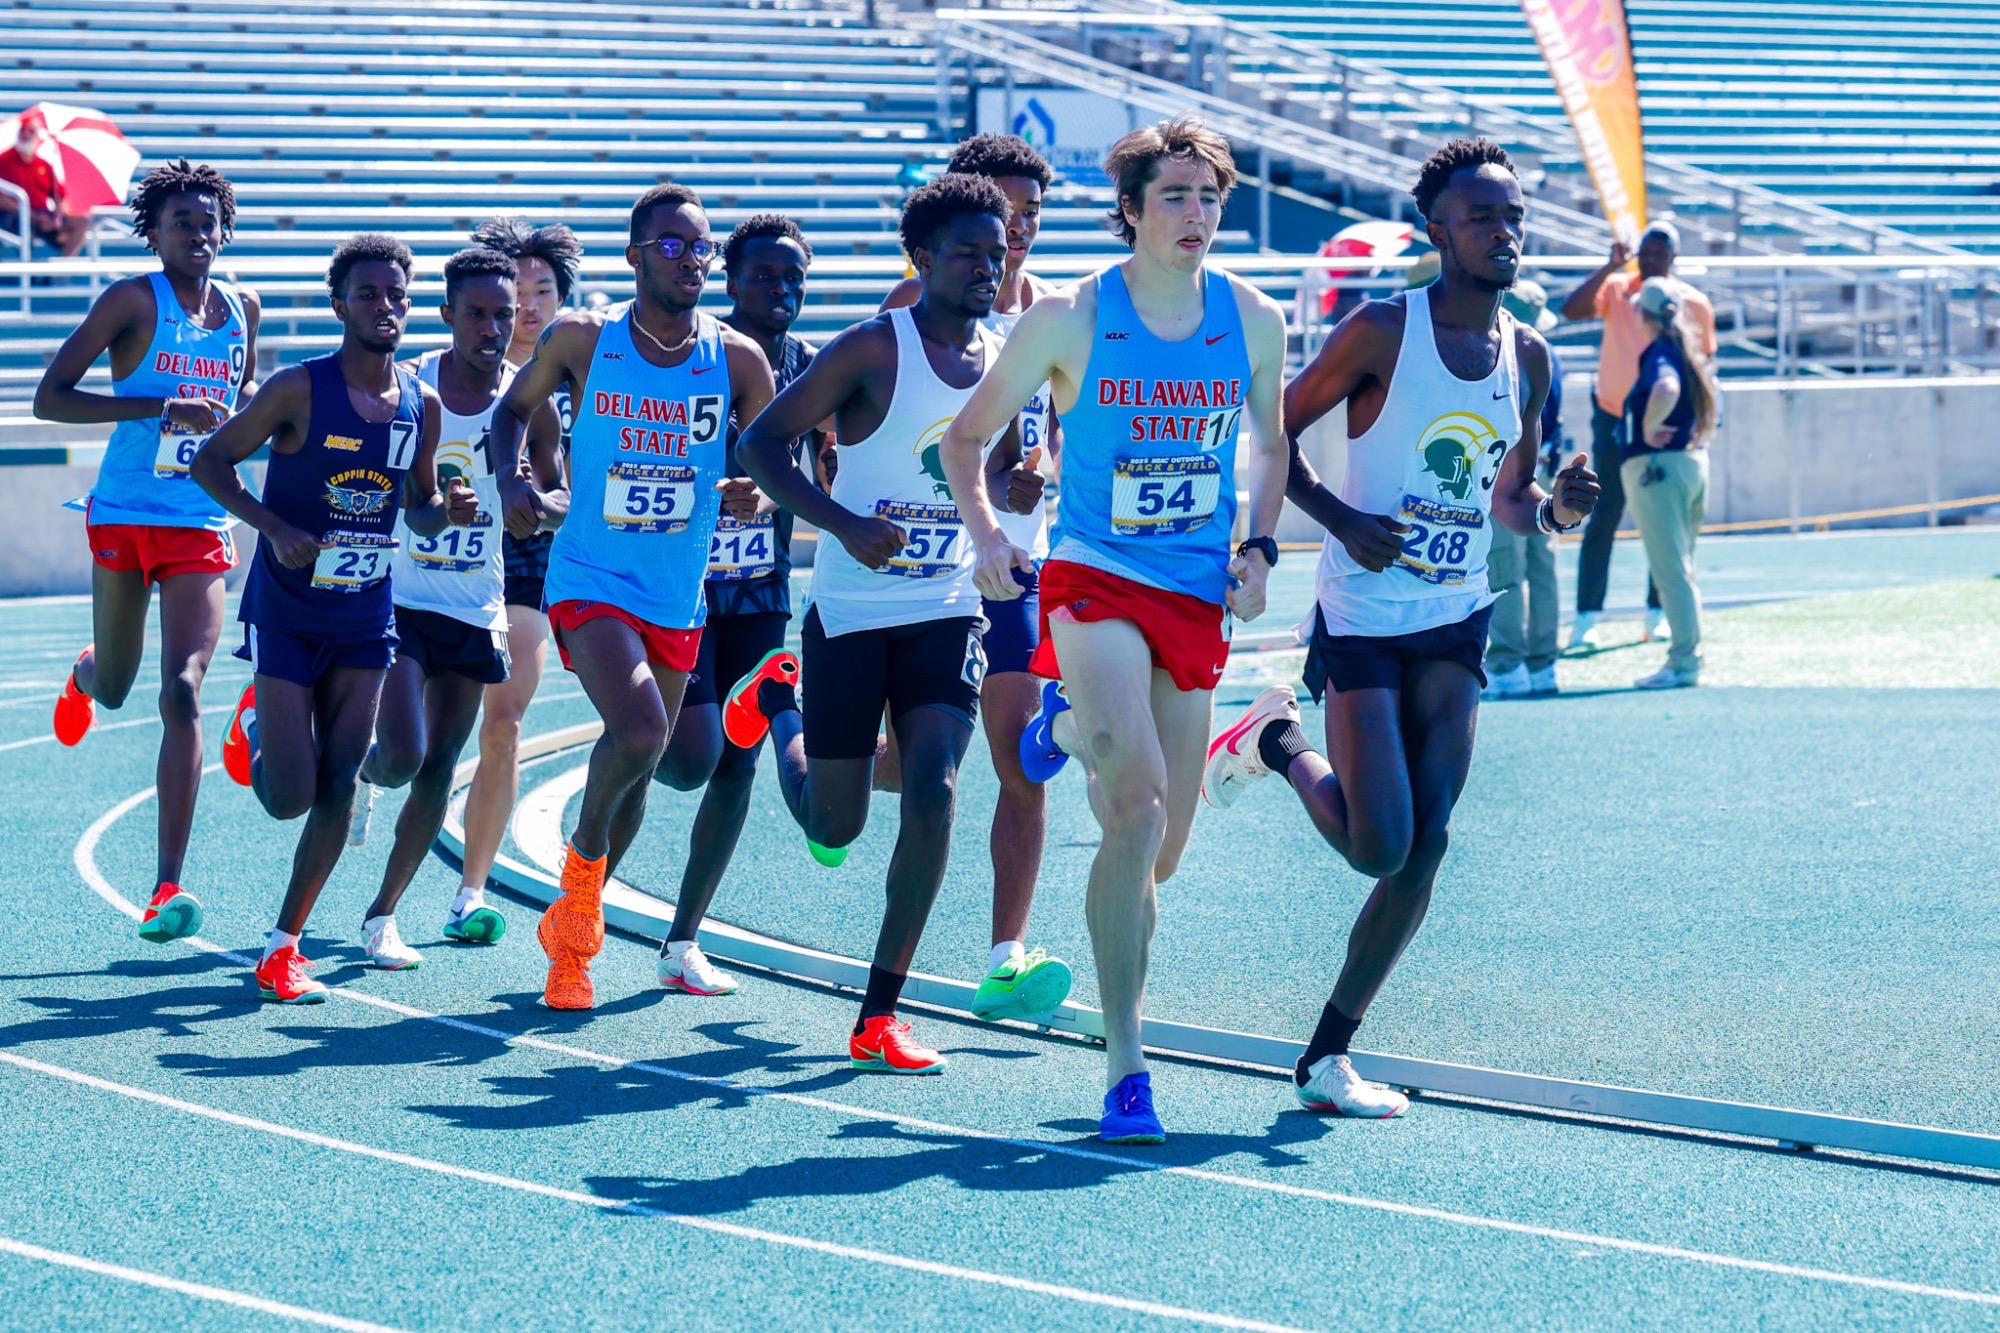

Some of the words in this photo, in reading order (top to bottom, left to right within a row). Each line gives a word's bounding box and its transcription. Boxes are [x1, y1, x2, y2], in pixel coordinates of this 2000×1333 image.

[1104, 332, 1130, 340] MEAC
[154, 351, 229, 382] DELAWA
[230, 345, 244, 387] 9
[602, 352, 624, 360] MEAC
[1098, 378, 1240, 407] DELAWARE
[595, 390, 689, 427] DELAWA
[692, 396, 718, 443] 5
[163, 424, 188, 432] TRAC
[1131, 415, 1209, 442] STATE
[176, 438, 208, 466] 6
[323, 434, 363, 452] MEAC
[392, 421, 414, 468] 7
[619, 427, 689, 458] STATE
[612, 466, 648, 477] TRACK
[663, 470, 692, 478] FIELD
[1119, 462, 1162, 472] TRACK
[1179, 461, 1216, 470] FIELD
[1171, 455, 1205, 464] OUTDOOR
[1482, 439, 1507, 490] 3
[330, 469, 365, 486] COPPIN
[367, 470, 393, 491] STATE
[625, 485, 676, 516] 55
[879, 505, 917, 517] TRACK
[1137, 480, 1196, 516] 54
[1408, 501, 1448, 519] TRACK
[1450, 511, 1481, 523] FIELD
[328, 534, 361, 544] TRACK
[416, 529, 484, 559] 315
[709, 532, 768, 564] 214
[895, 527, 958, 560] 57
[1401, 523, 1469, 565] 268
[333, 551, 379, 578] 23
